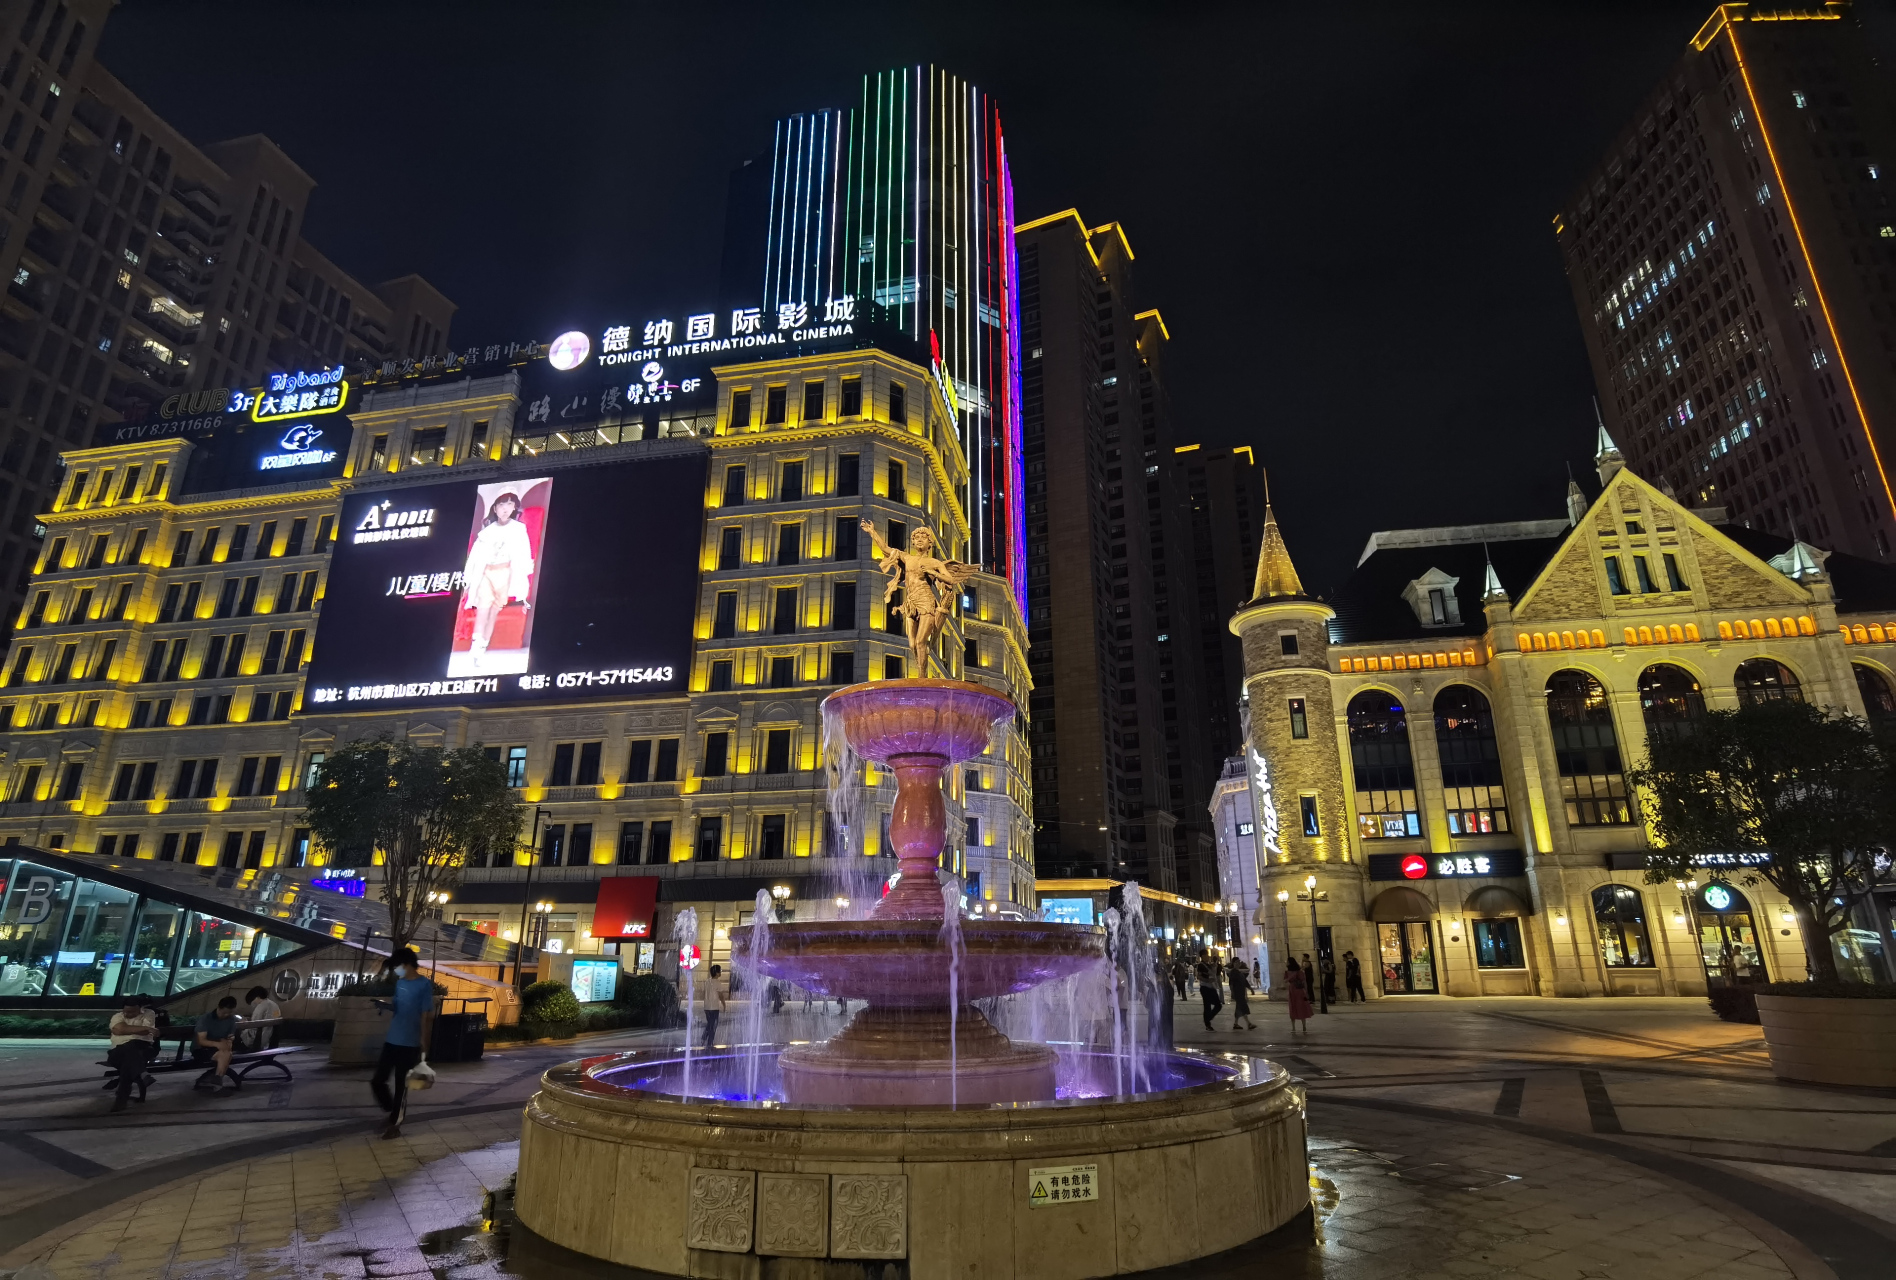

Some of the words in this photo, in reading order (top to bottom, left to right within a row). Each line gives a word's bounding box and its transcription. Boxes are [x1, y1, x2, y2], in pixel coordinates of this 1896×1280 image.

[602, 294, 855, 353] 德纳国际影城
[598, 347, 662, 366] TONIGHT
[667, 334, 786, 358] INTERNATIONAL
[792, 323, 854, 343] CINEMA
[270, 365, 345, 394] Bigband
[681, 378, 702, 393] 6F
[160, 388, 230, 420] CLUB
[227, 392, 255, 413] 3F
[115, 425, 148, 440] KTV
[322, 451, 338, 463] 6F
[384, 508, 435, 528] MODEL
[556, 666, 673, 688] 0571-57115443
[1438, 857, 1491, 875] 必胜客
[17, 875, 55, 924] B
[622, 924, 647, 934] KFC
[1050, 1173, 1091, 1188] 有电危险
[1050, 1186, 1092, 1200] 请勿戏水
